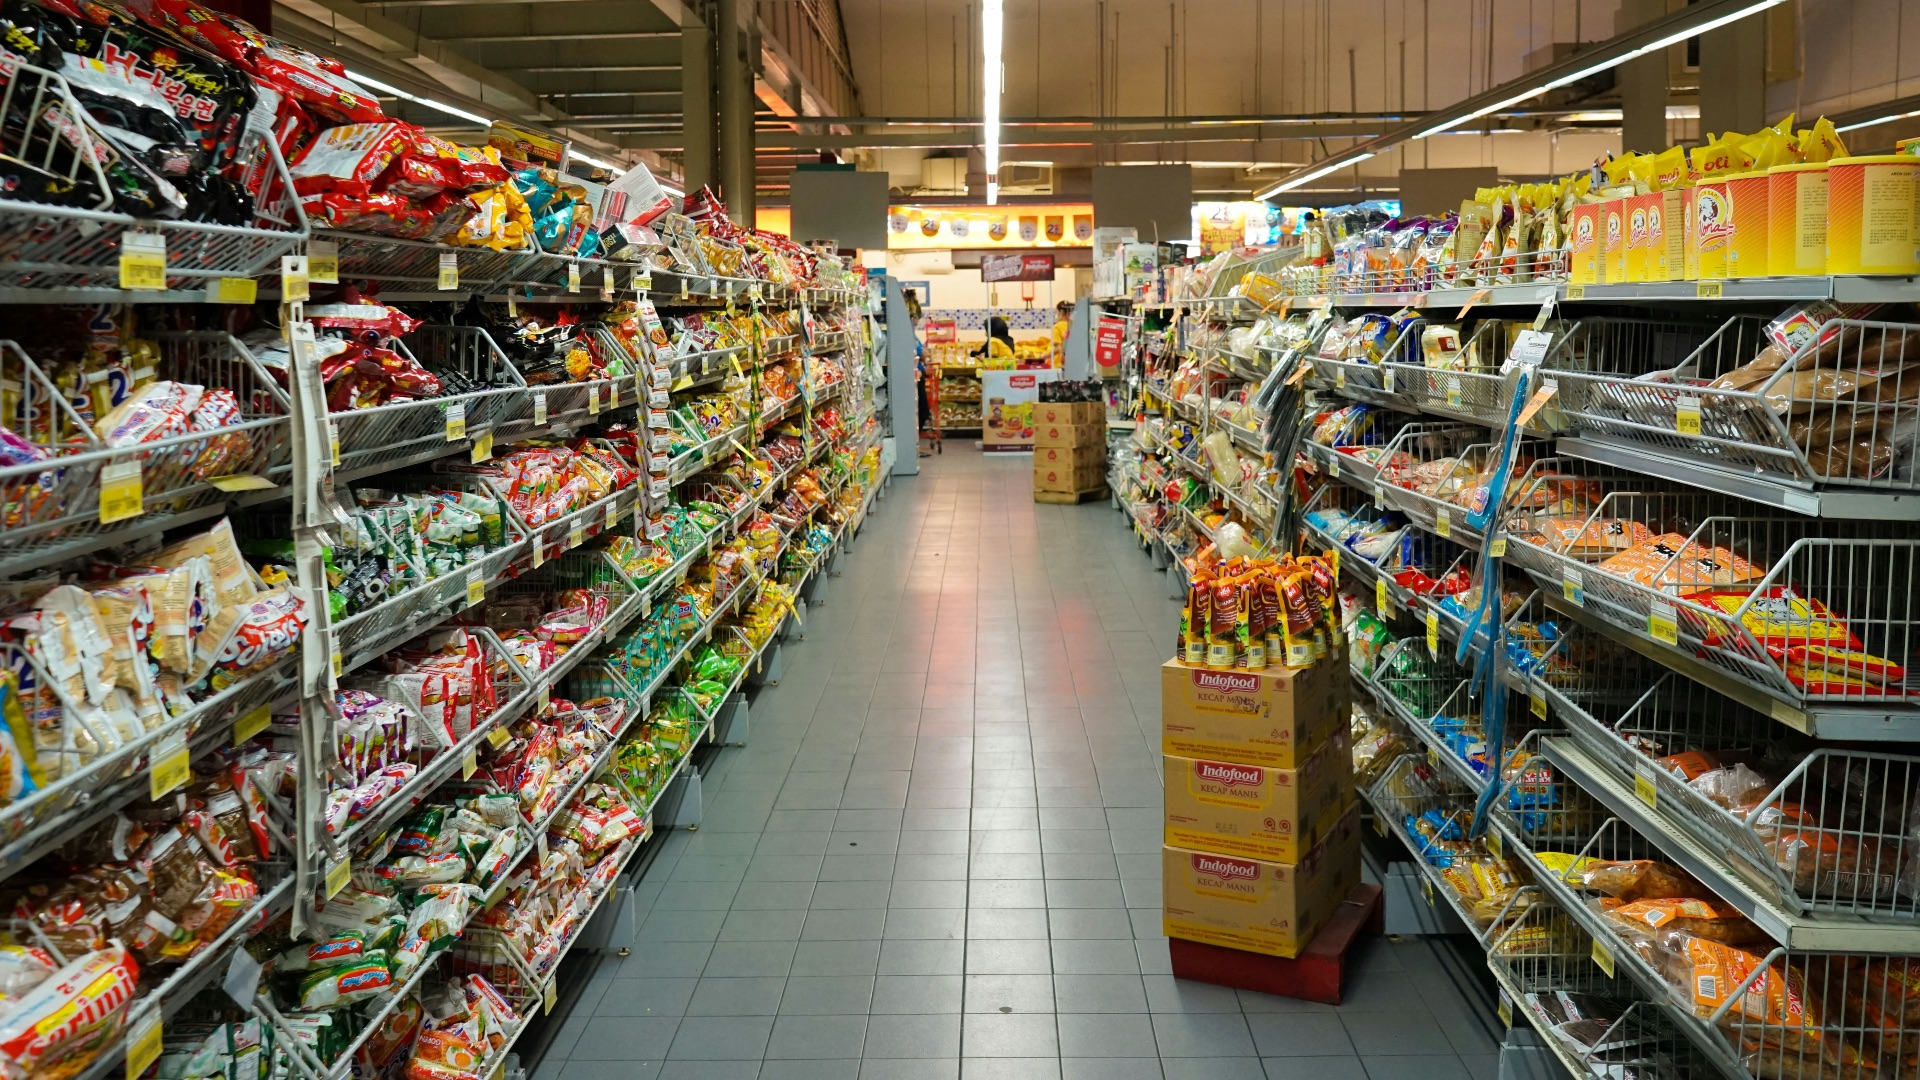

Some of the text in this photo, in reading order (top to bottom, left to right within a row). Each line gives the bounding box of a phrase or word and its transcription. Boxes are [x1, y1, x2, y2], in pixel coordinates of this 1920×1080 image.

[1199, 673, 1256, 690] Indofood
[1198, 692, 1225, 702] KECAP
[1202, 764, 1259, 782] Indofood
[1201, 784, 1259, 799] KECAP MANIS
[1199, 858, 1255, 877] Indofood
[1198, 877, 1255, 893] KECAP MANIS
